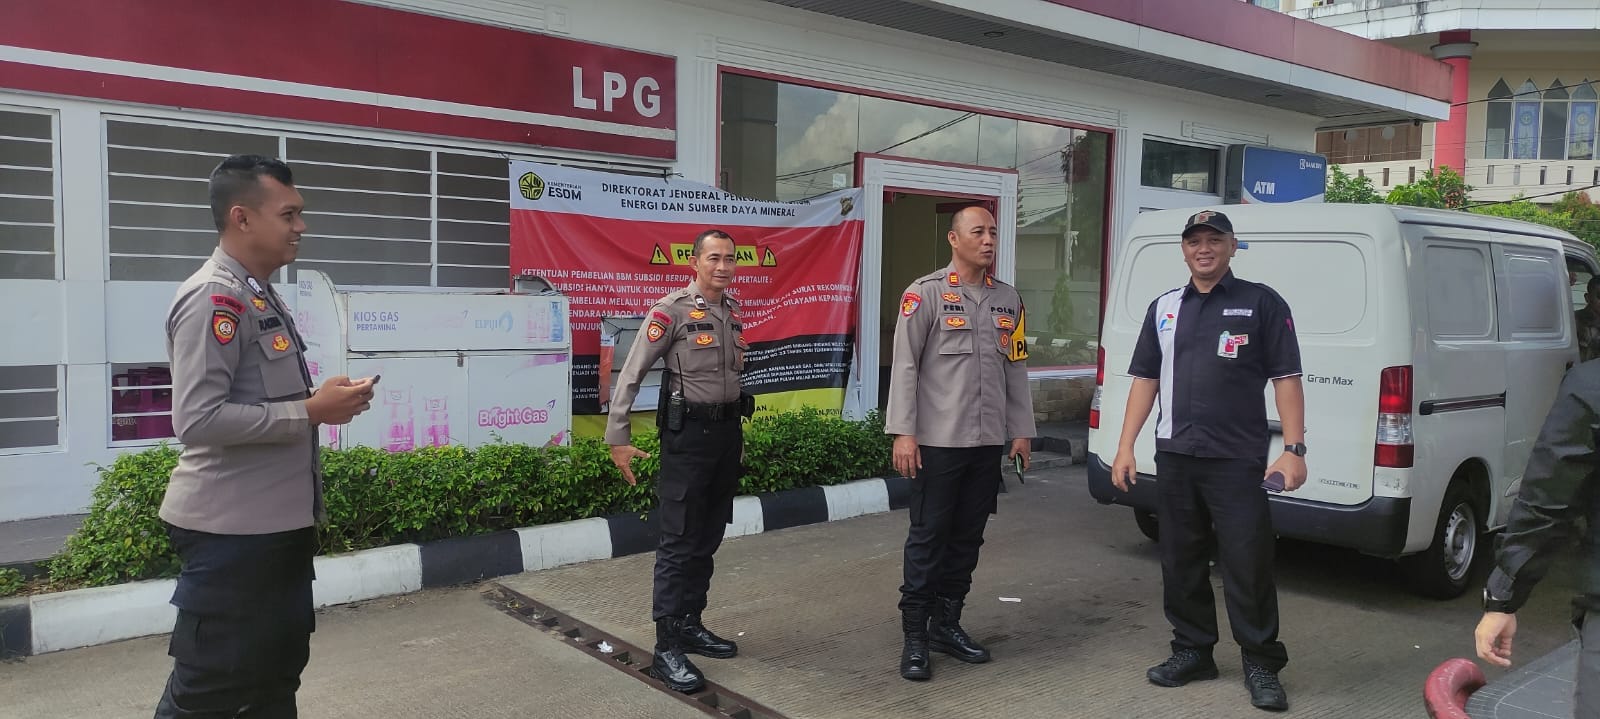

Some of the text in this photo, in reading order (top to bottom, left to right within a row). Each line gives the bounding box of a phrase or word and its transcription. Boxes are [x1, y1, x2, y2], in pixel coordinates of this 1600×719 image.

[572, 65, 661, 118] LPG
[548, 187, 582, 201] ESDM
[602, 182, 666, 198] DIREKTORAT
[669, 188, 720, 201] JENDERAL
[1253, 181, 1275, 195] ATM
[621, 199, 796, 217] ENERGI DAN SUMBER DAYA MINERAL
[521, 268, 569, 278] KETENTUAN
[571, 270, 613, 281] PEMBELIAN
[616, 272, 632, 281] BBM
[634, 274, 663, 282] SUBSIDI
[568, 296, 607, 305] EMBELIAN
[608, 298, 641, 306] MELALUI
[792, 284, 816, 295] SURAT
[585, 284, 615, 294] HANYA
[616, 286, 641, 294] UNTUK
[568, 309, 612, 318] ENDARAAN
[943, 304, 965, 312] FERI
[990, 306, 1015, 316] POLRI
[353, 311, 399, 322] KIOS GAS
[356, 323, 397, 331] PERTAMINA
[1307, 374, 1354, 386] Gran Max
[478, 407, 548, 428] Bright Gas
